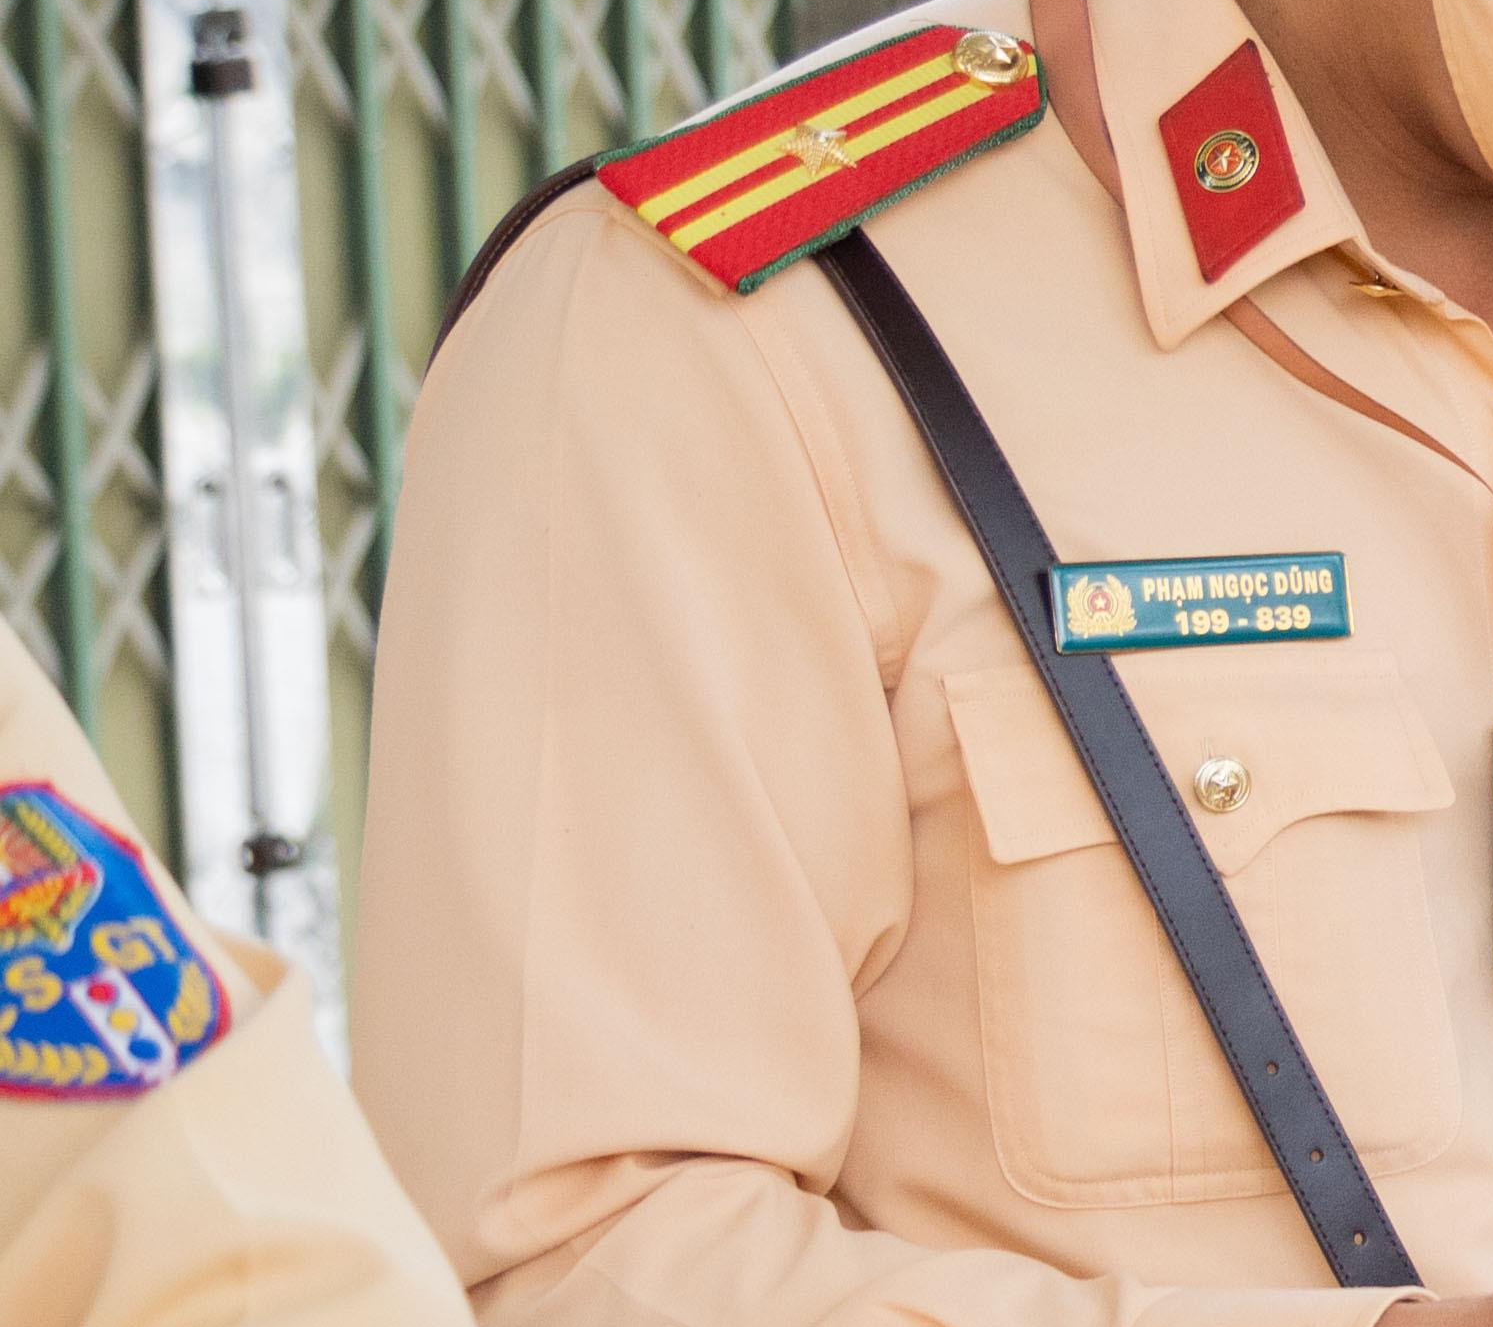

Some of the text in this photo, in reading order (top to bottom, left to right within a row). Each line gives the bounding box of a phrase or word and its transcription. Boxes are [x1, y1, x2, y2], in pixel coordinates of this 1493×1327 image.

[1143, 565, 1333, 608] PHẠM NGỌC DŨNG
[1175, 608, 1230, 636] 199
[1256, 603, 1312, 632] 839
